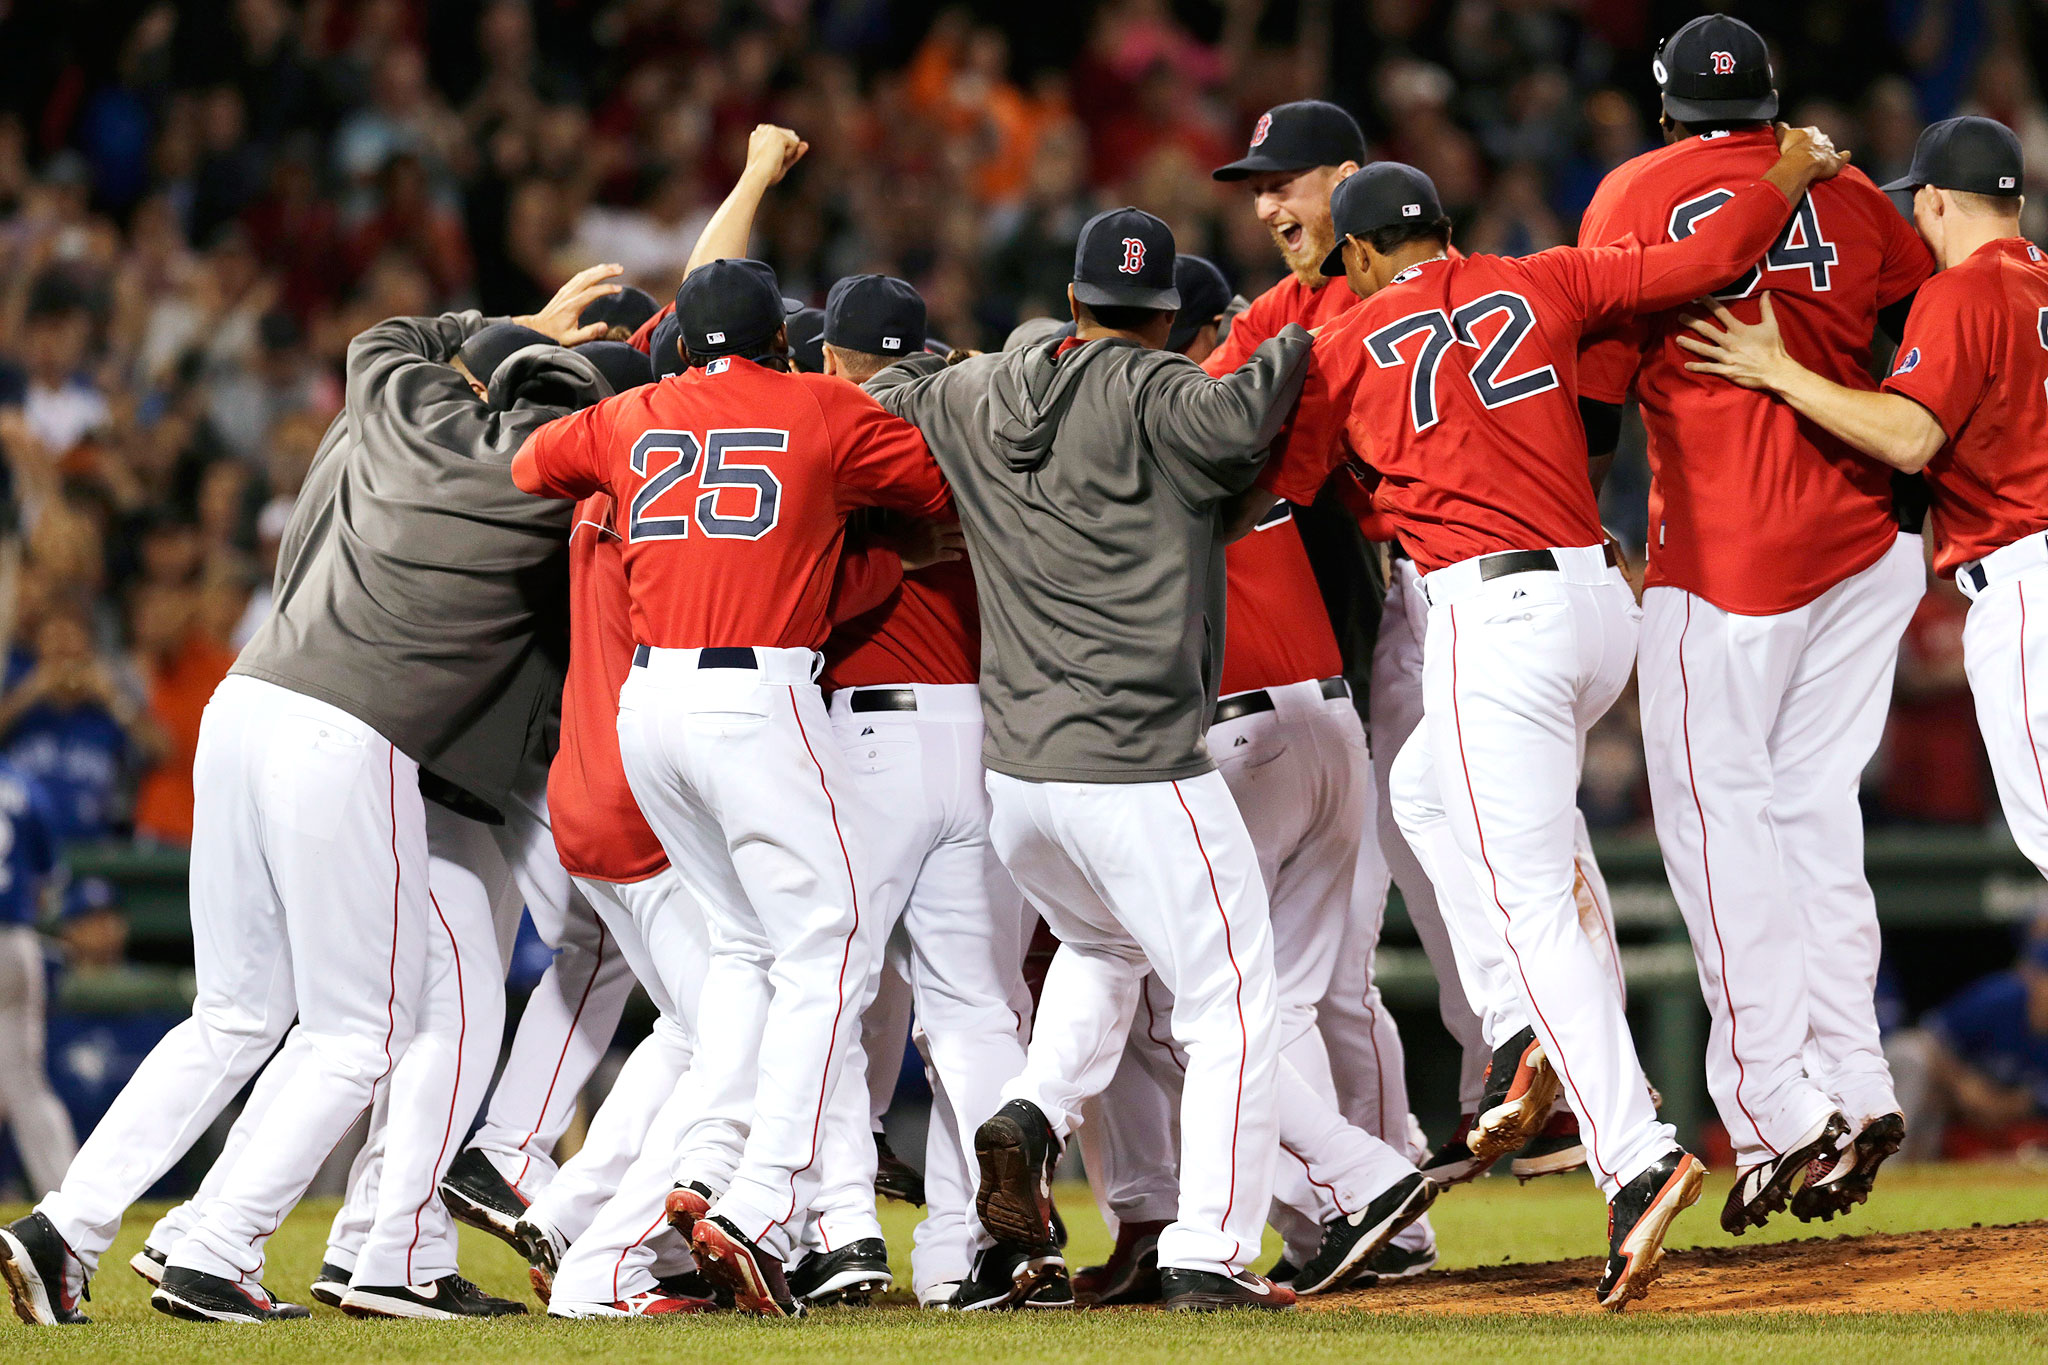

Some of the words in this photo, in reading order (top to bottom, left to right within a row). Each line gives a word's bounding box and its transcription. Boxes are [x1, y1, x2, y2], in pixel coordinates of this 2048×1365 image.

[1250, 113, 1273, 147] B
[1118, 238, 1147, 274] B
[1363, 290, 1559, 433] 72
[629, 428, 790, 544] 25
